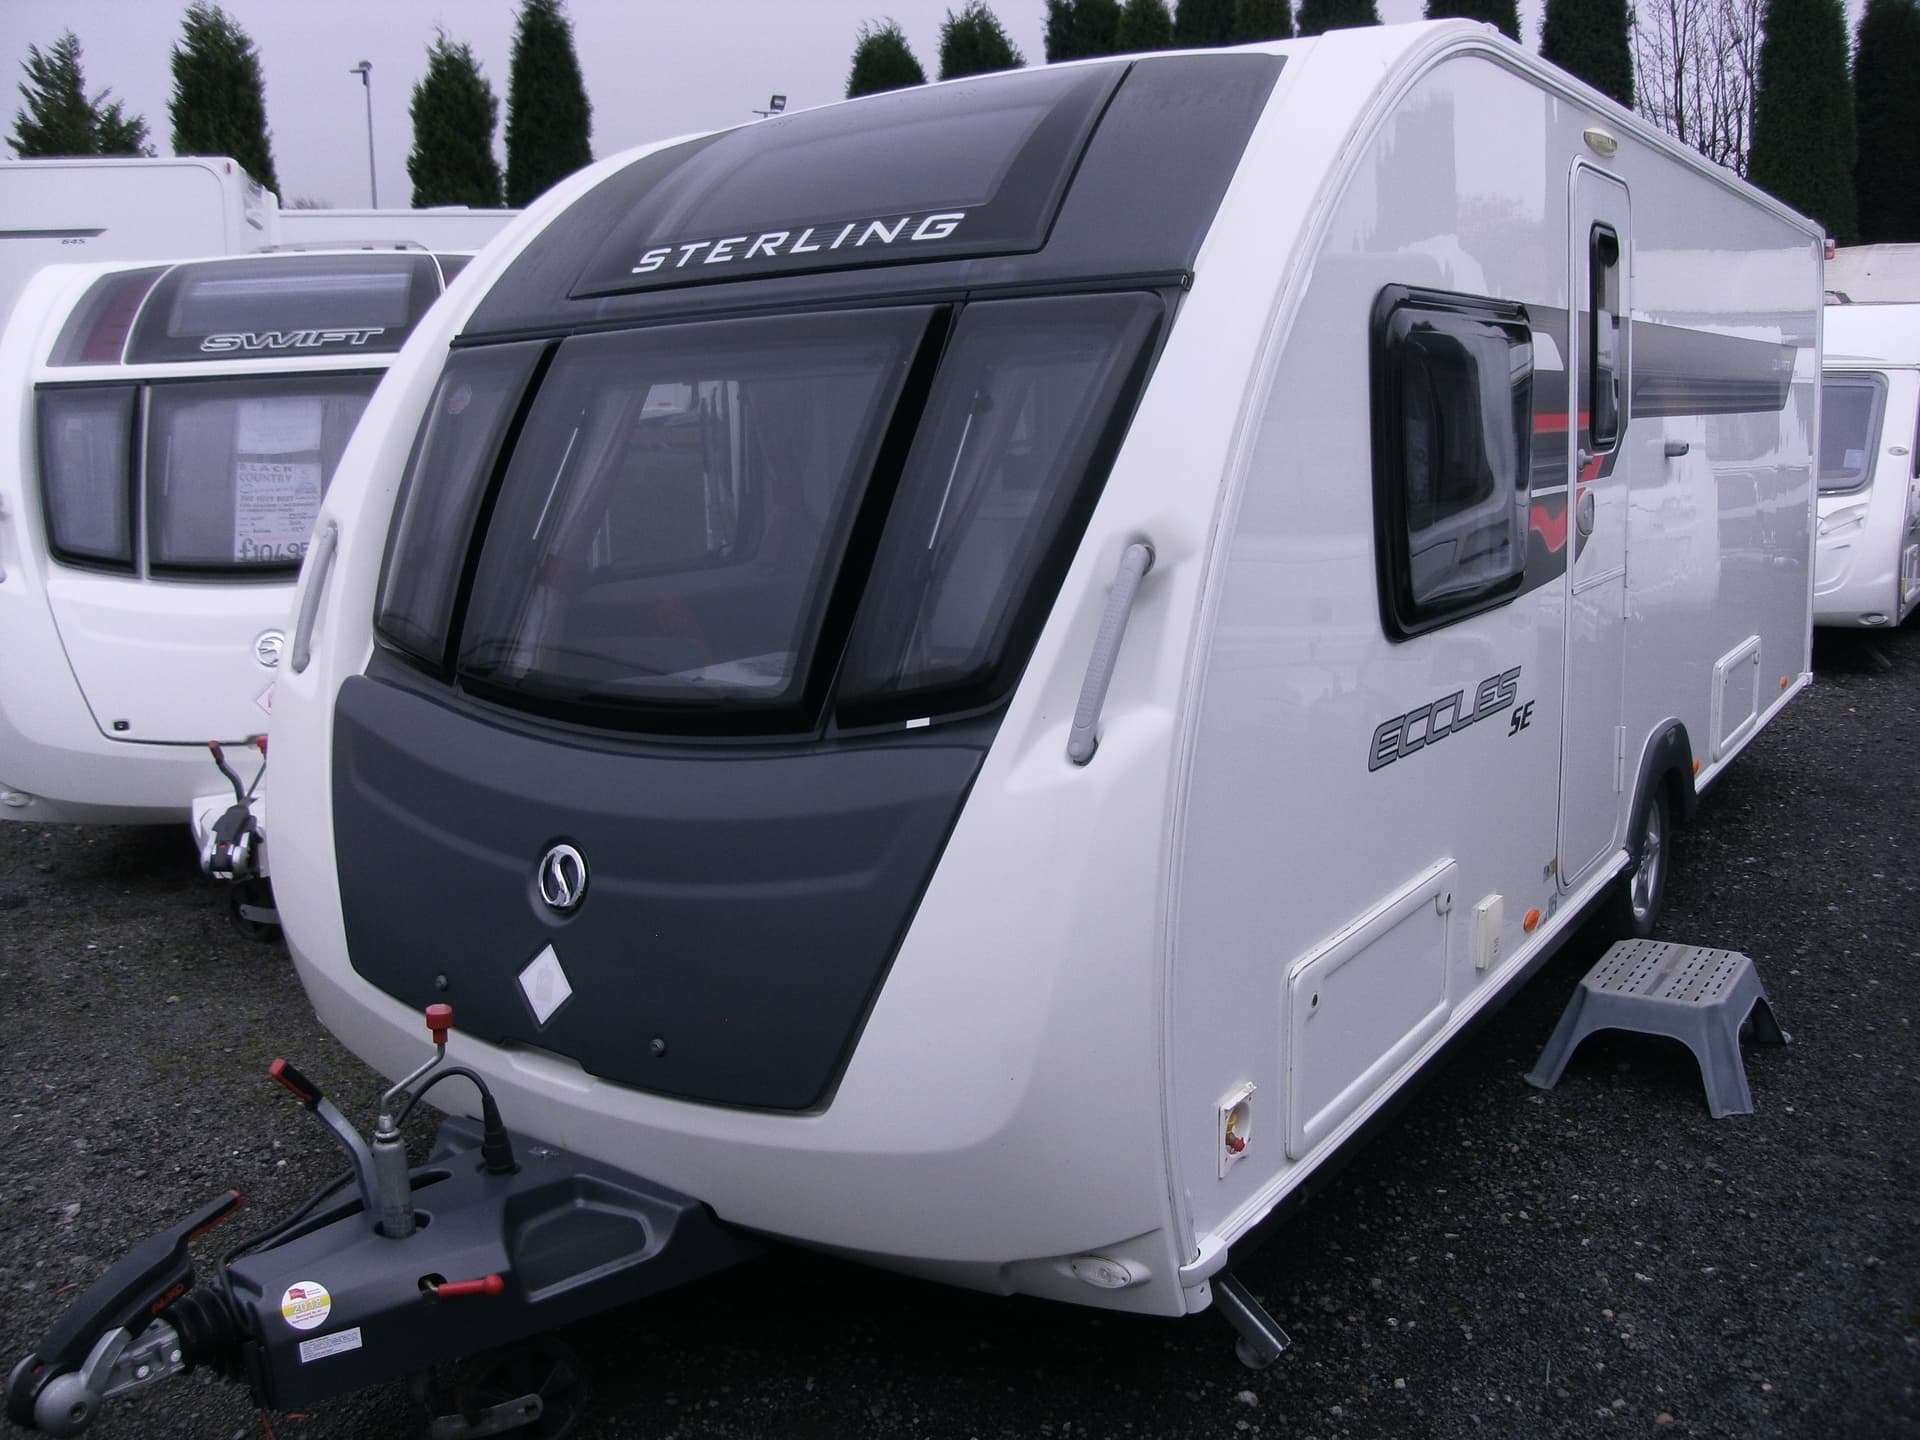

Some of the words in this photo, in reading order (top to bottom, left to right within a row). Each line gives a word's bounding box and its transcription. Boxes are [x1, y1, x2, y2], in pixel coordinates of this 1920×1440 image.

[632, 212, 965, 274] STERLING
[201, 328, 385, 351] SWIFT
[1368, 665, 1521, 772] ECCLES
[1507, 700, 1535, 737] SE
